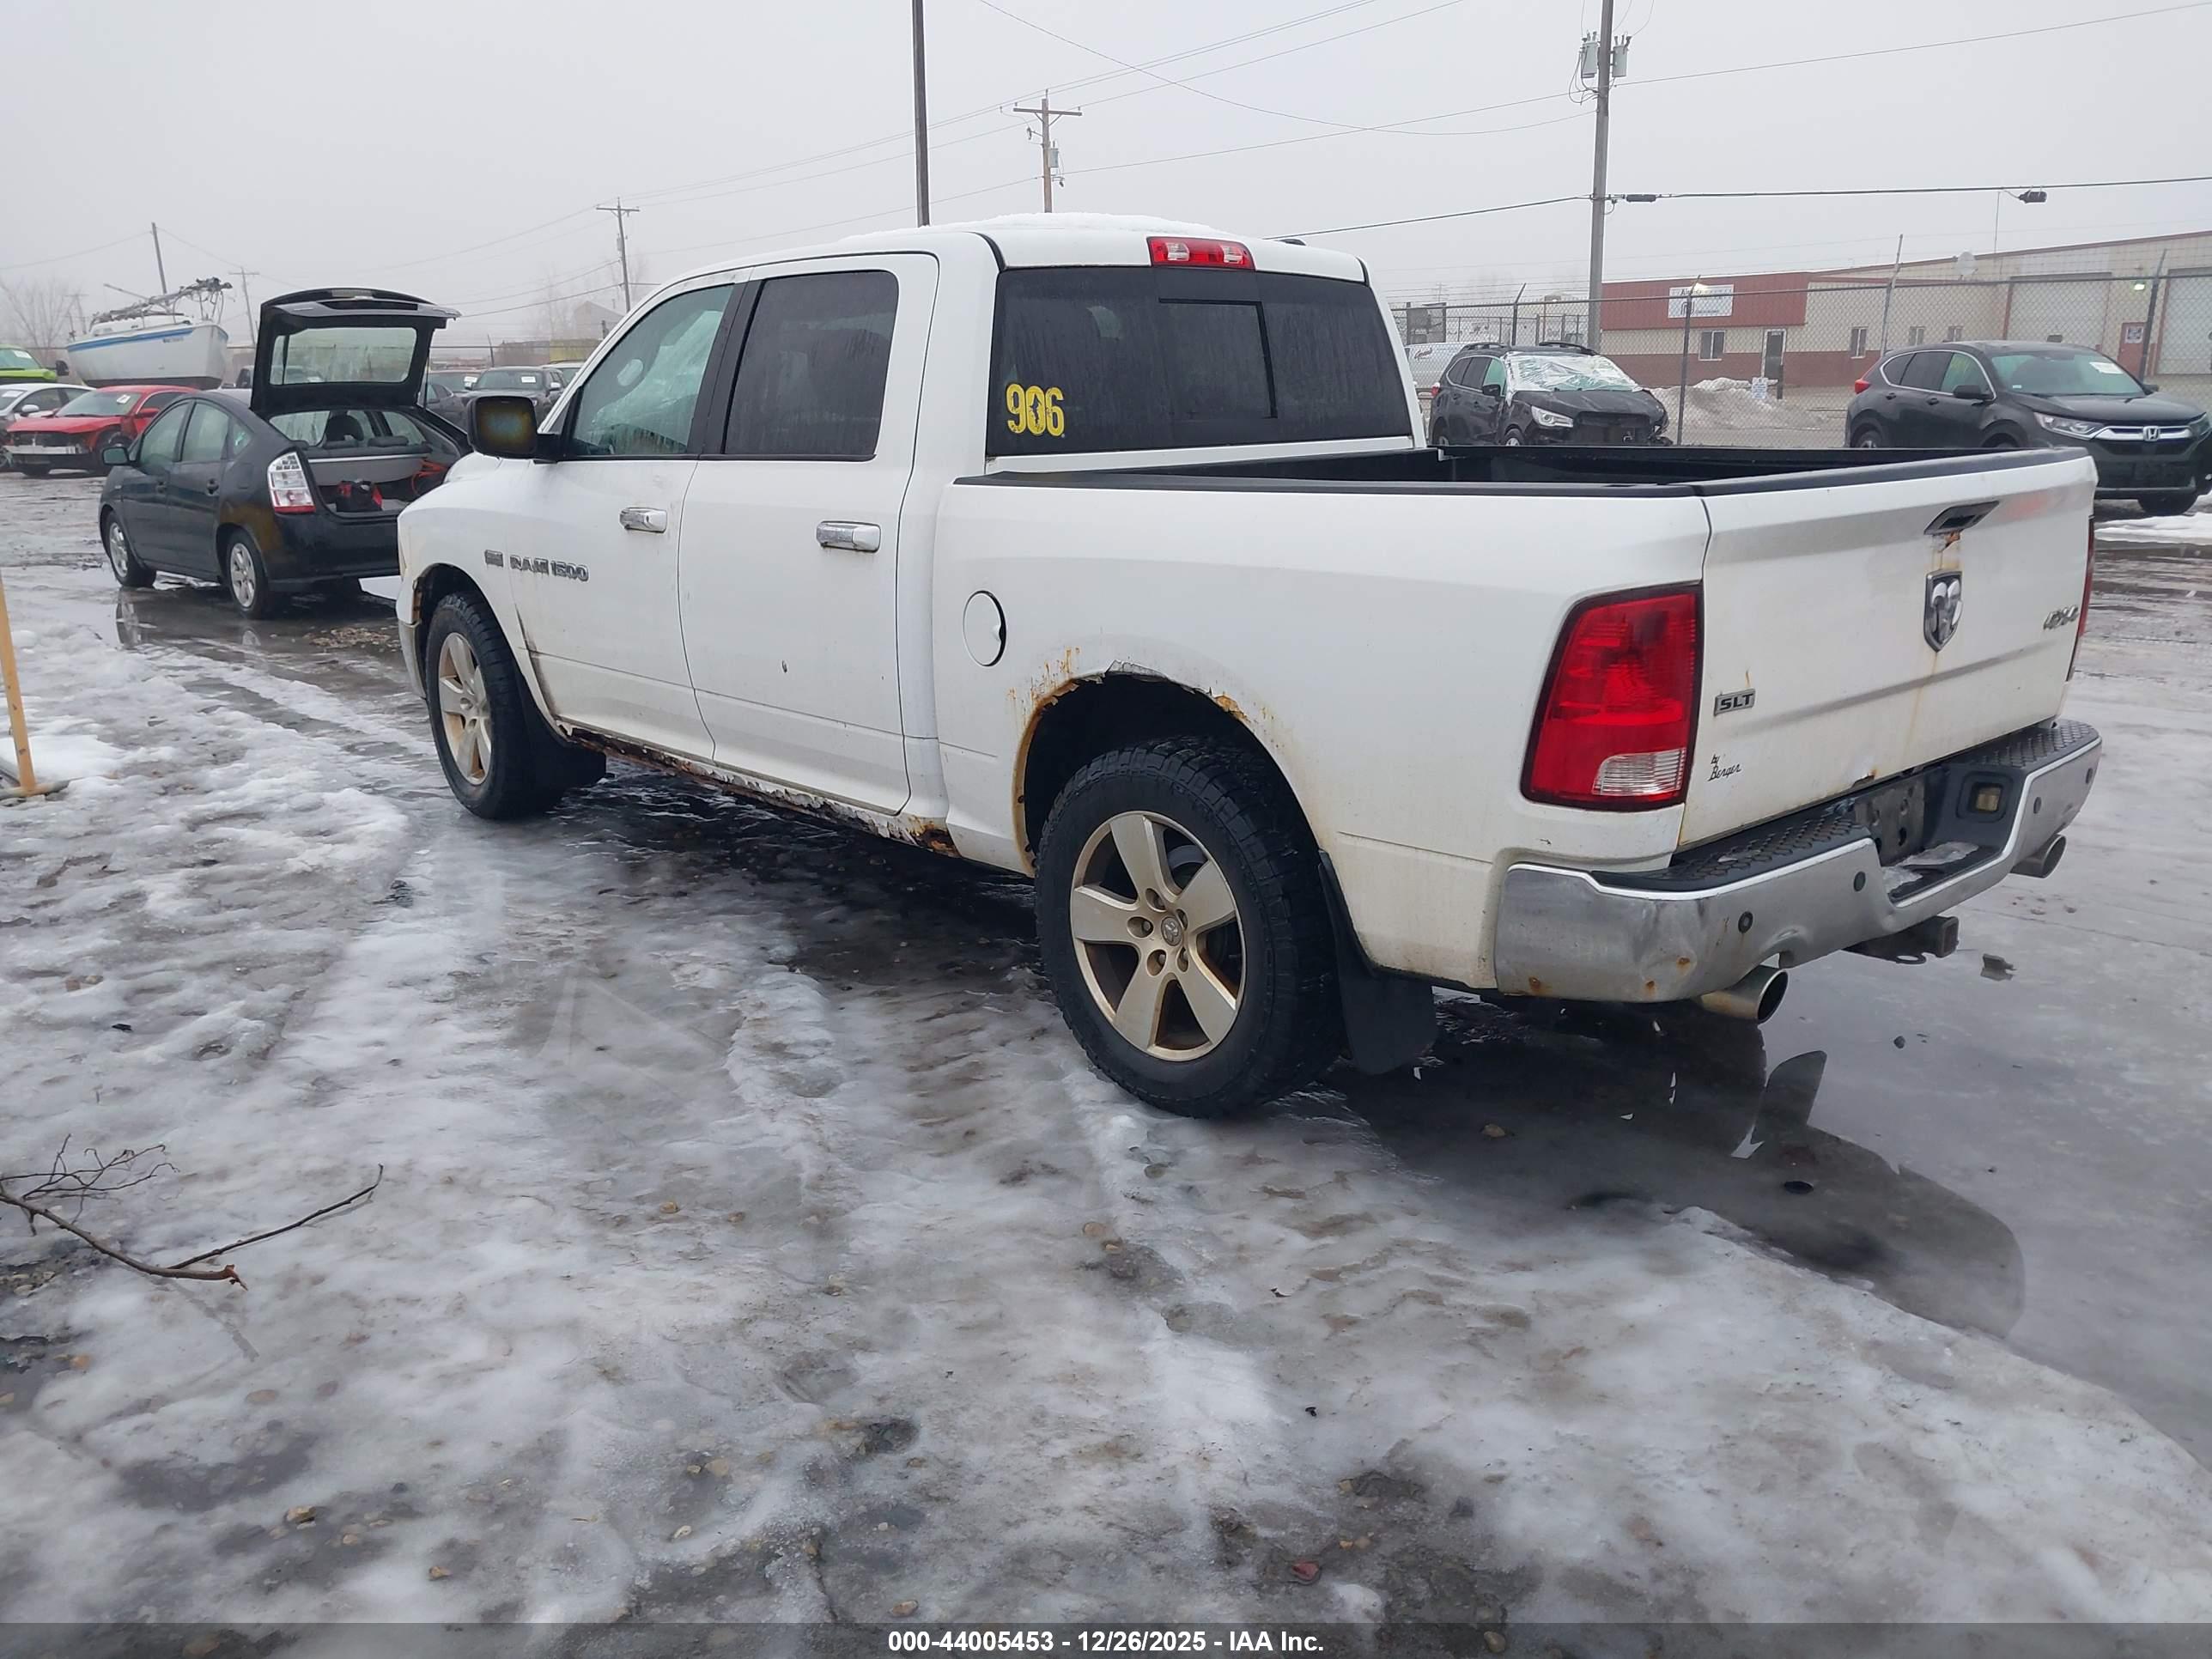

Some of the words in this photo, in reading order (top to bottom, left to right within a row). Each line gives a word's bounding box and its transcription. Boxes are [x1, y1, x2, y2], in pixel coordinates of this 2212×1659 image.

[1006, 383, 1065, 437] 906
[509, 555, 550, 575] RAM
[550, 560, 589, 582] 1500
[1719, 692, 1754, 711] SLT
